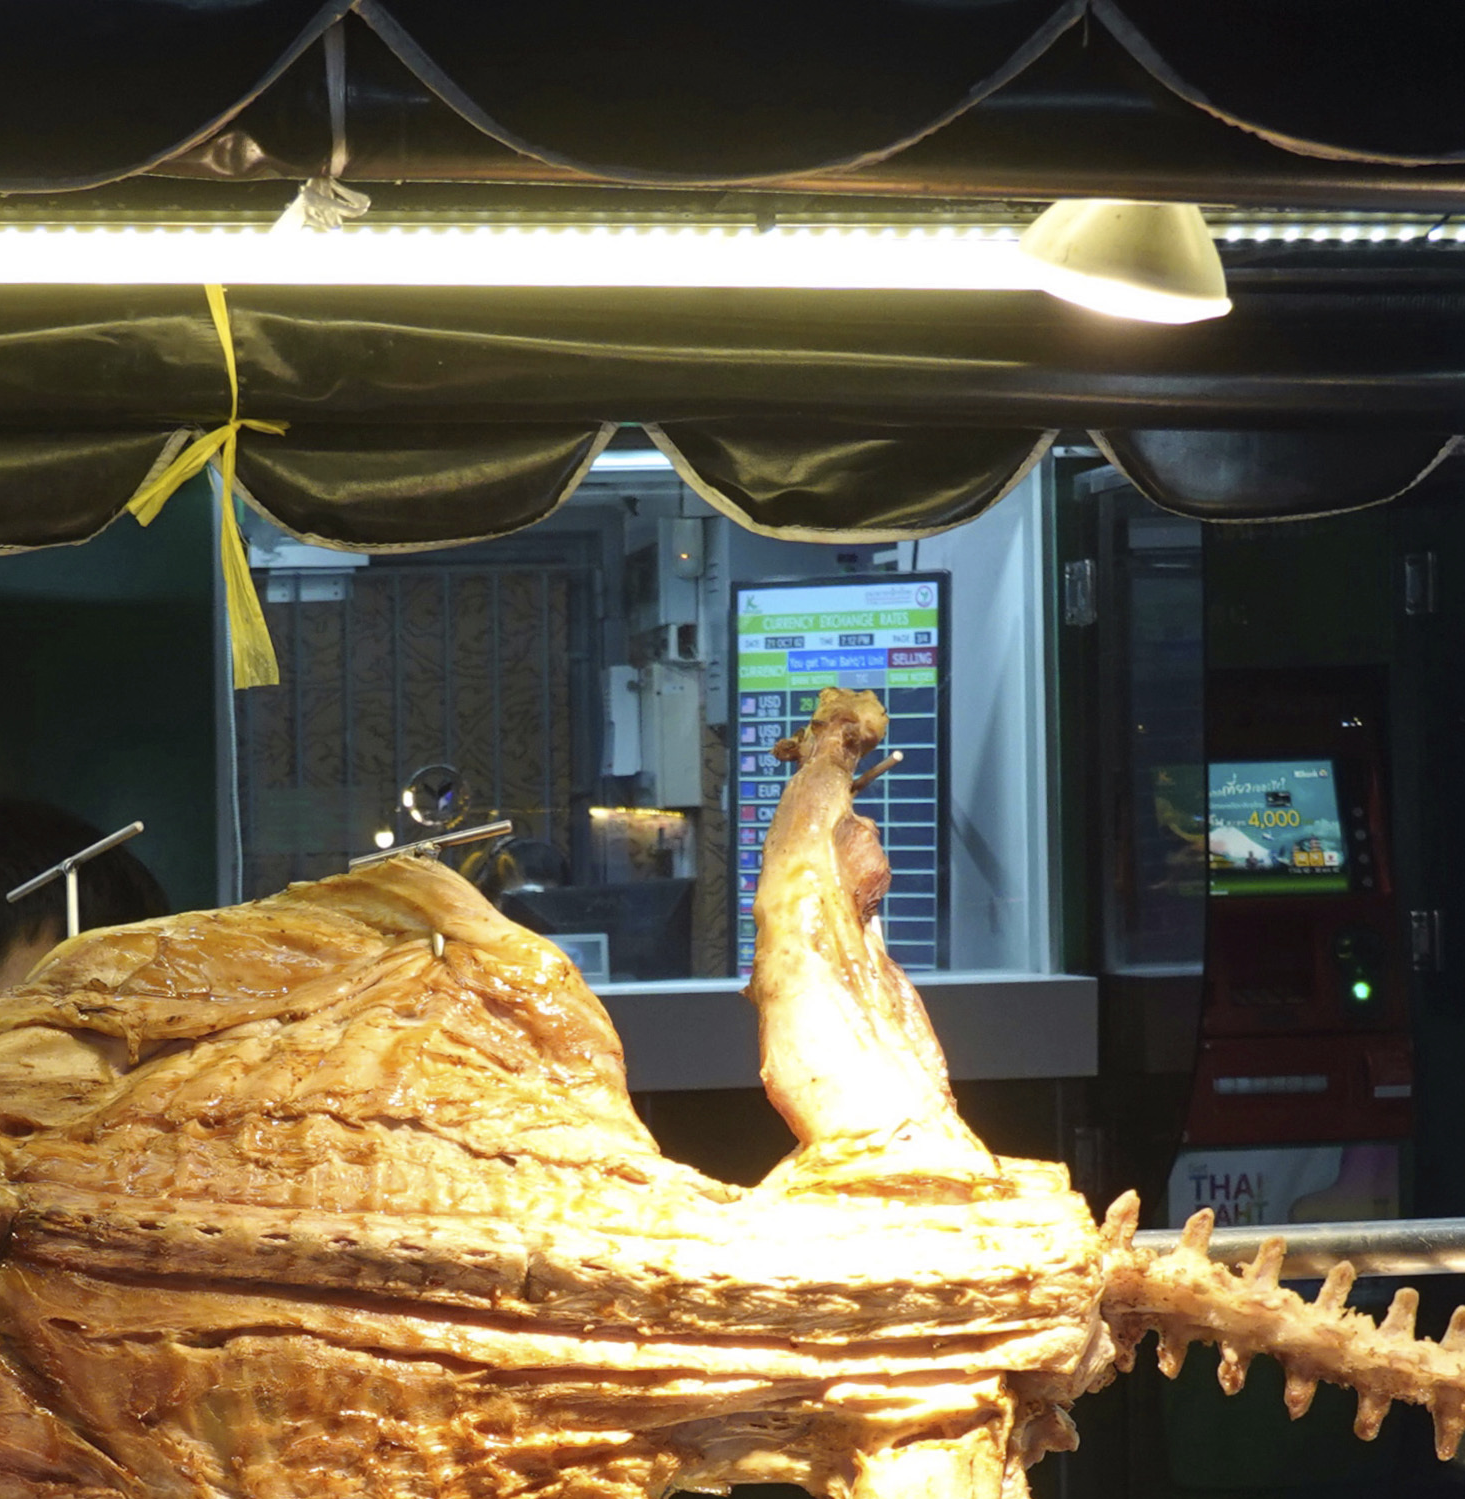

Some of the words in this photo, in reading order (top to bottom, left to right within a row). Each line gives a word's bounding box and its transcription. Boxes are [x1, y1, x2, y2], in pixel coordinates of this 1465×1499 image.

[762, 616, 815, 630] CURRENCY
[819, 613, 874, 628] EXCHANGE
[880, 612, 910, 626] RATES
[891, 652, 932, 666] SELLING
[758, 696, 781, 709] USD
[758, 725, 781, 738] USD
[758, 785, 781, 797] EUR
[1248, 810, 1300, 829] 4,000
[1194, 1200, 1269, 1227] AHT
